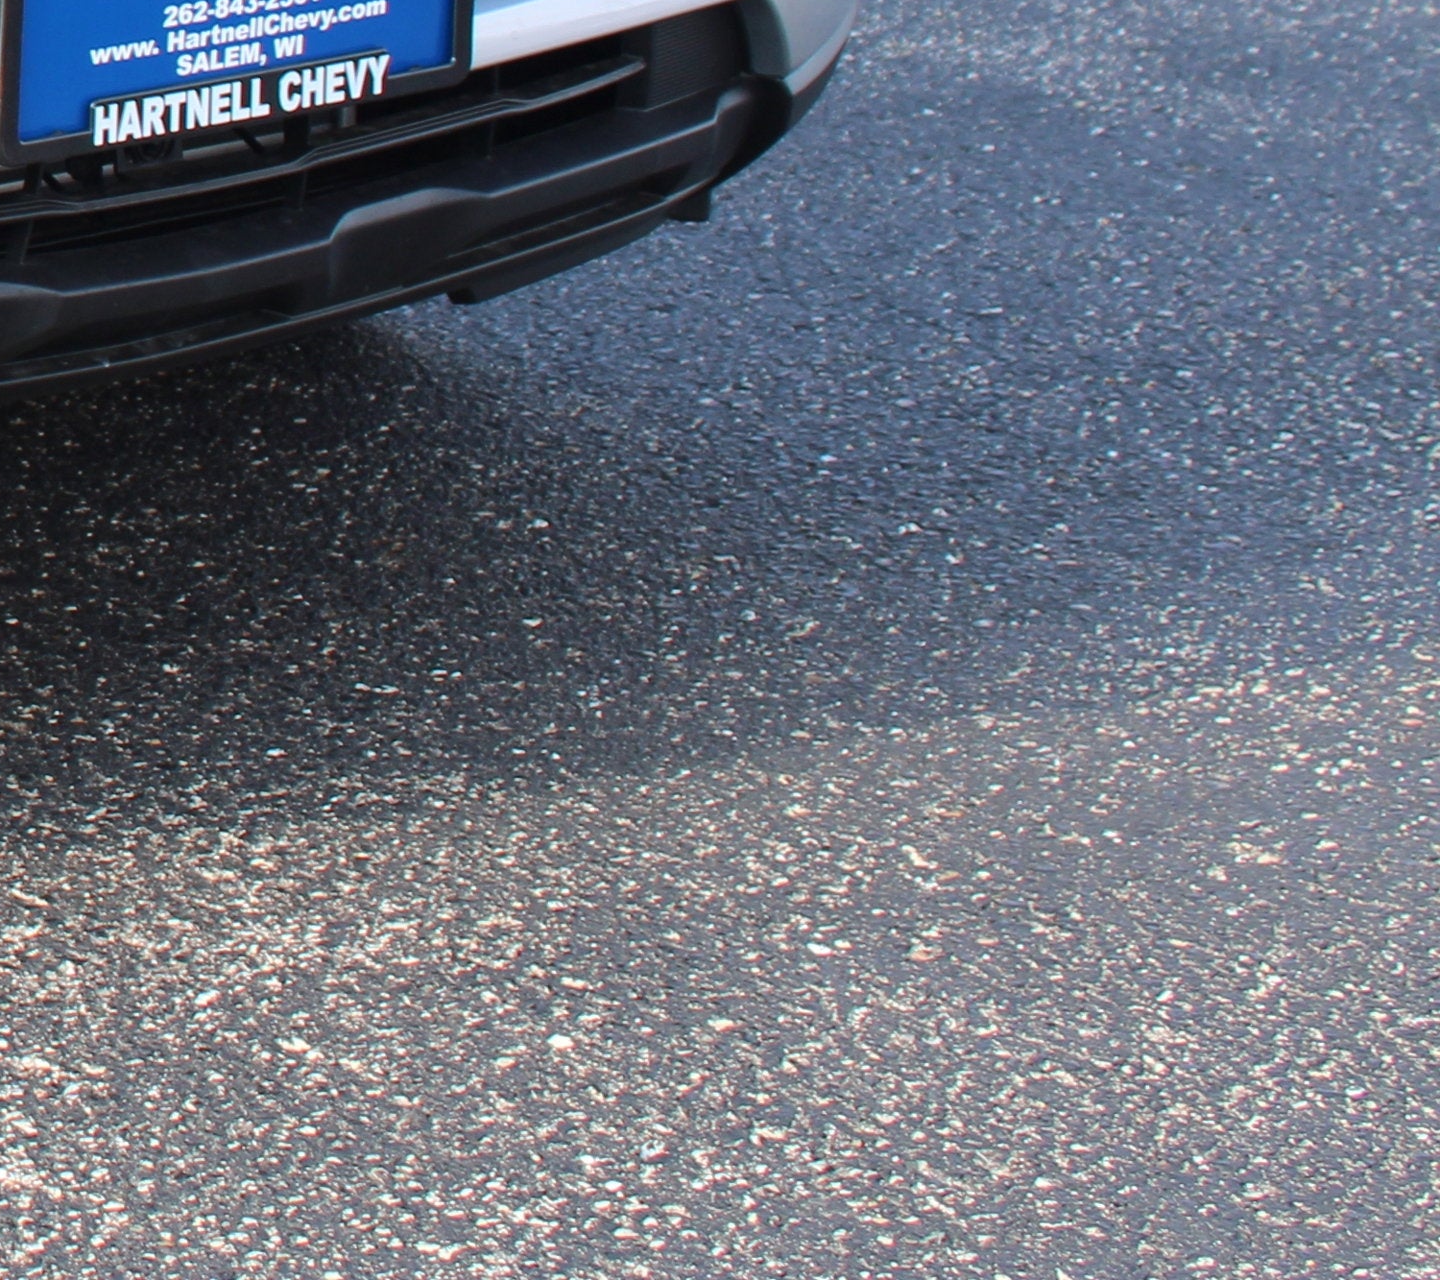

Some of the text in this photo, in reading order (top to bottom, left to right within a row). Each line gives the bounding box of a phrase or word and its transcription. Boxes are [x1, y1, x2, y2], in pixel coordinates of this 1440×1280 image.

[90, 34, 159, 66] www.
[176, 34, 304, 76] SALEM, WI
[92, 53, 391, 147] HARTNELL CHEVY
